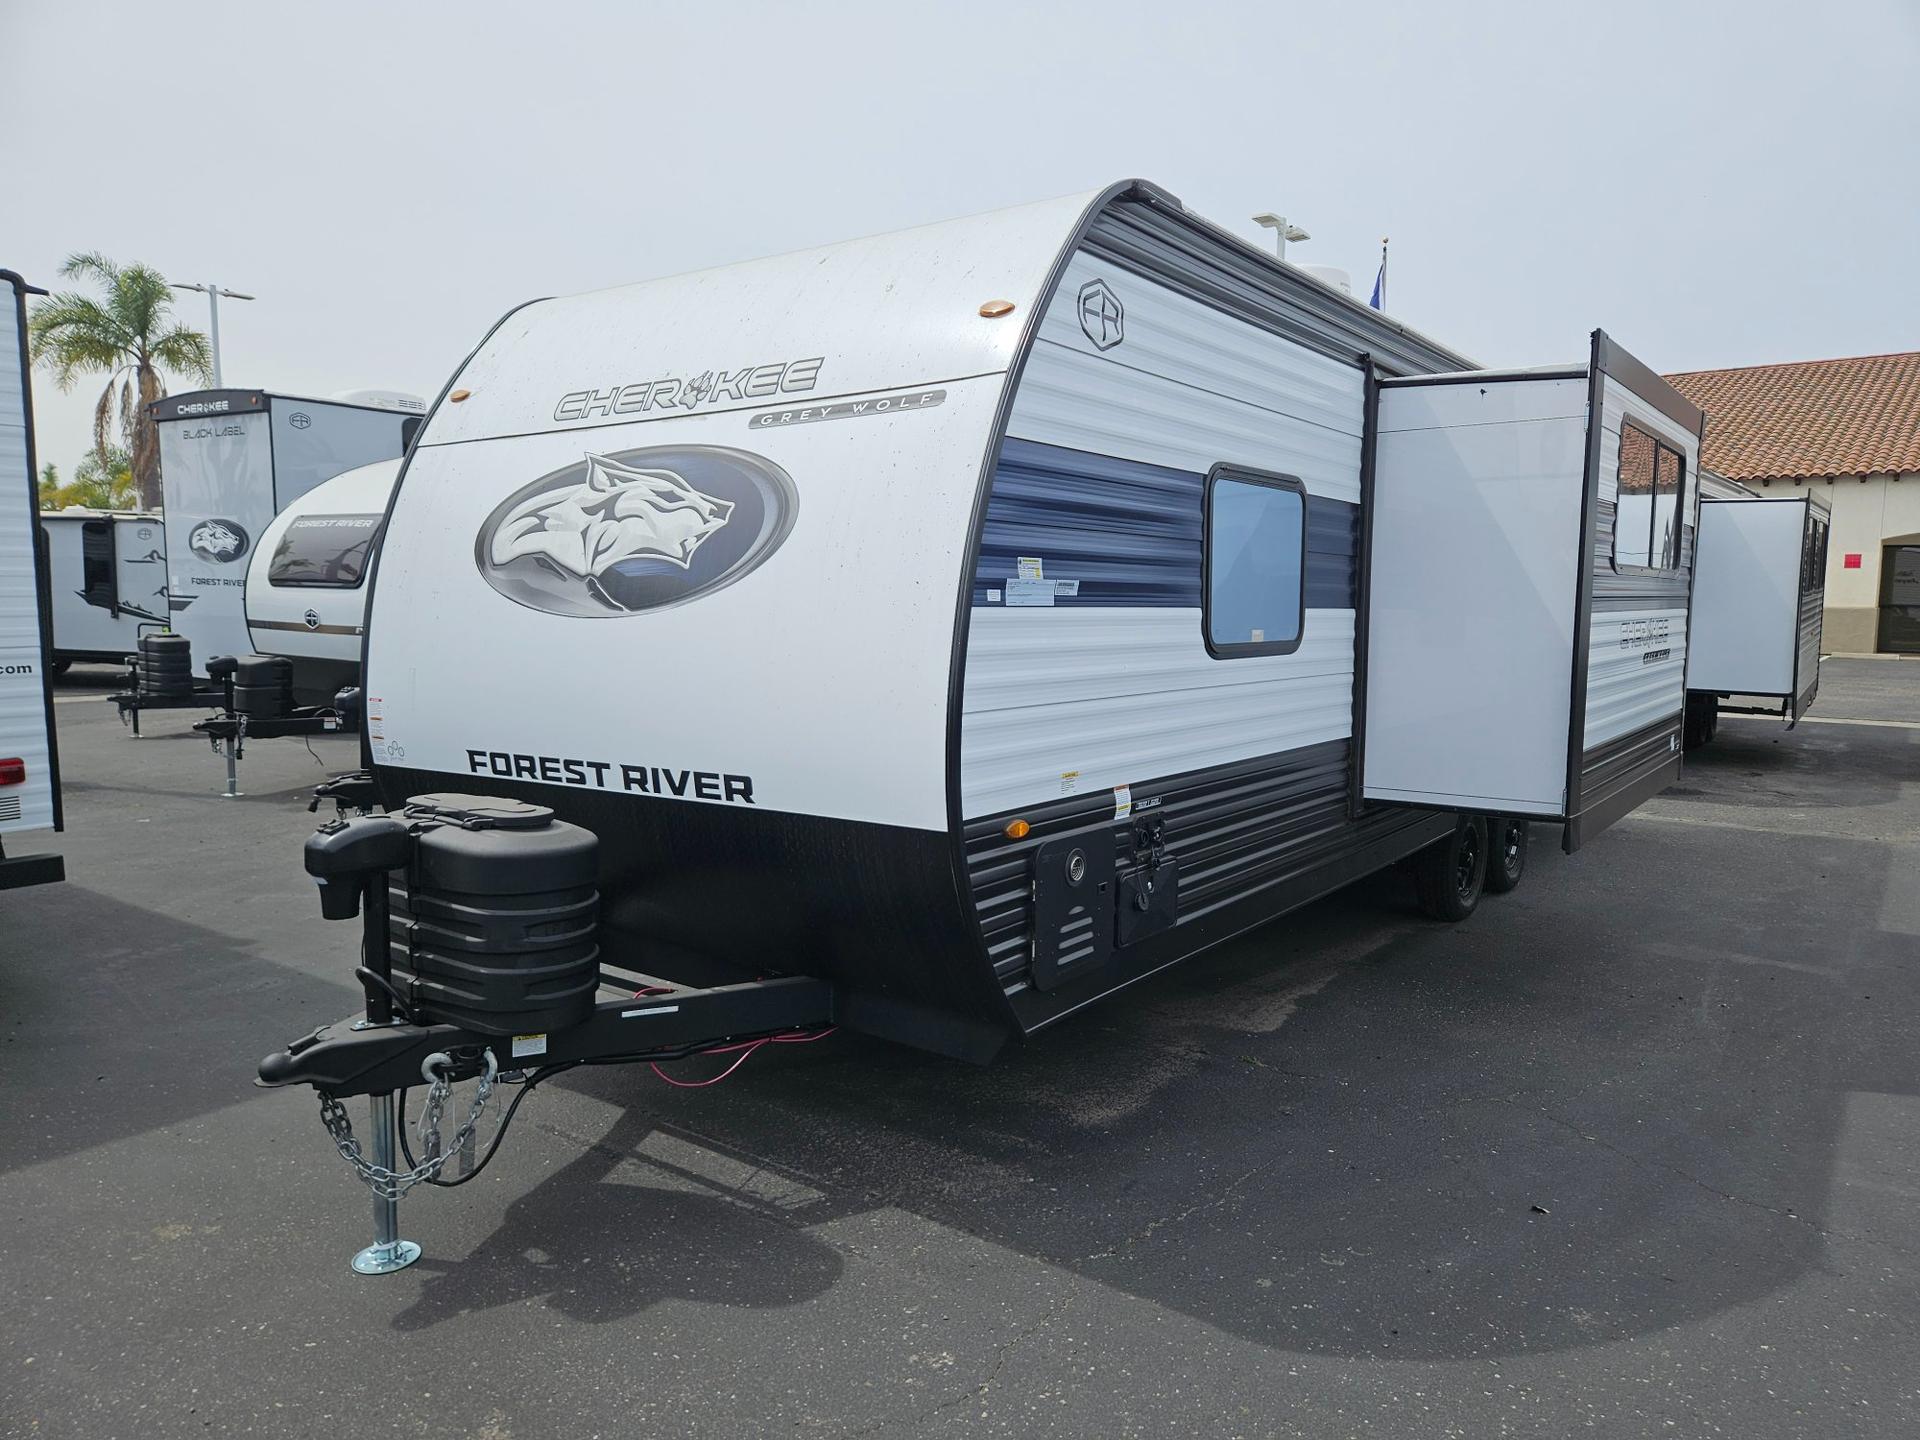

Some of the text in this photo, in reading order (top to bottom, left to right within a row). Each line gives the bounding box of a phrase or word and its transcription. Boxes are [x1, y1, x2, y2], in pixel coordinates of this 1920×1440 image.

[760, 393, 934, 425] GREY WOLF
[182, 425, 246, 440] BLACK LABEL
[335, 519, 374, 528] RIVER
[191, 577, 221, 586] FOREST
[465, 749, 756, 804] FOREST RIVER
